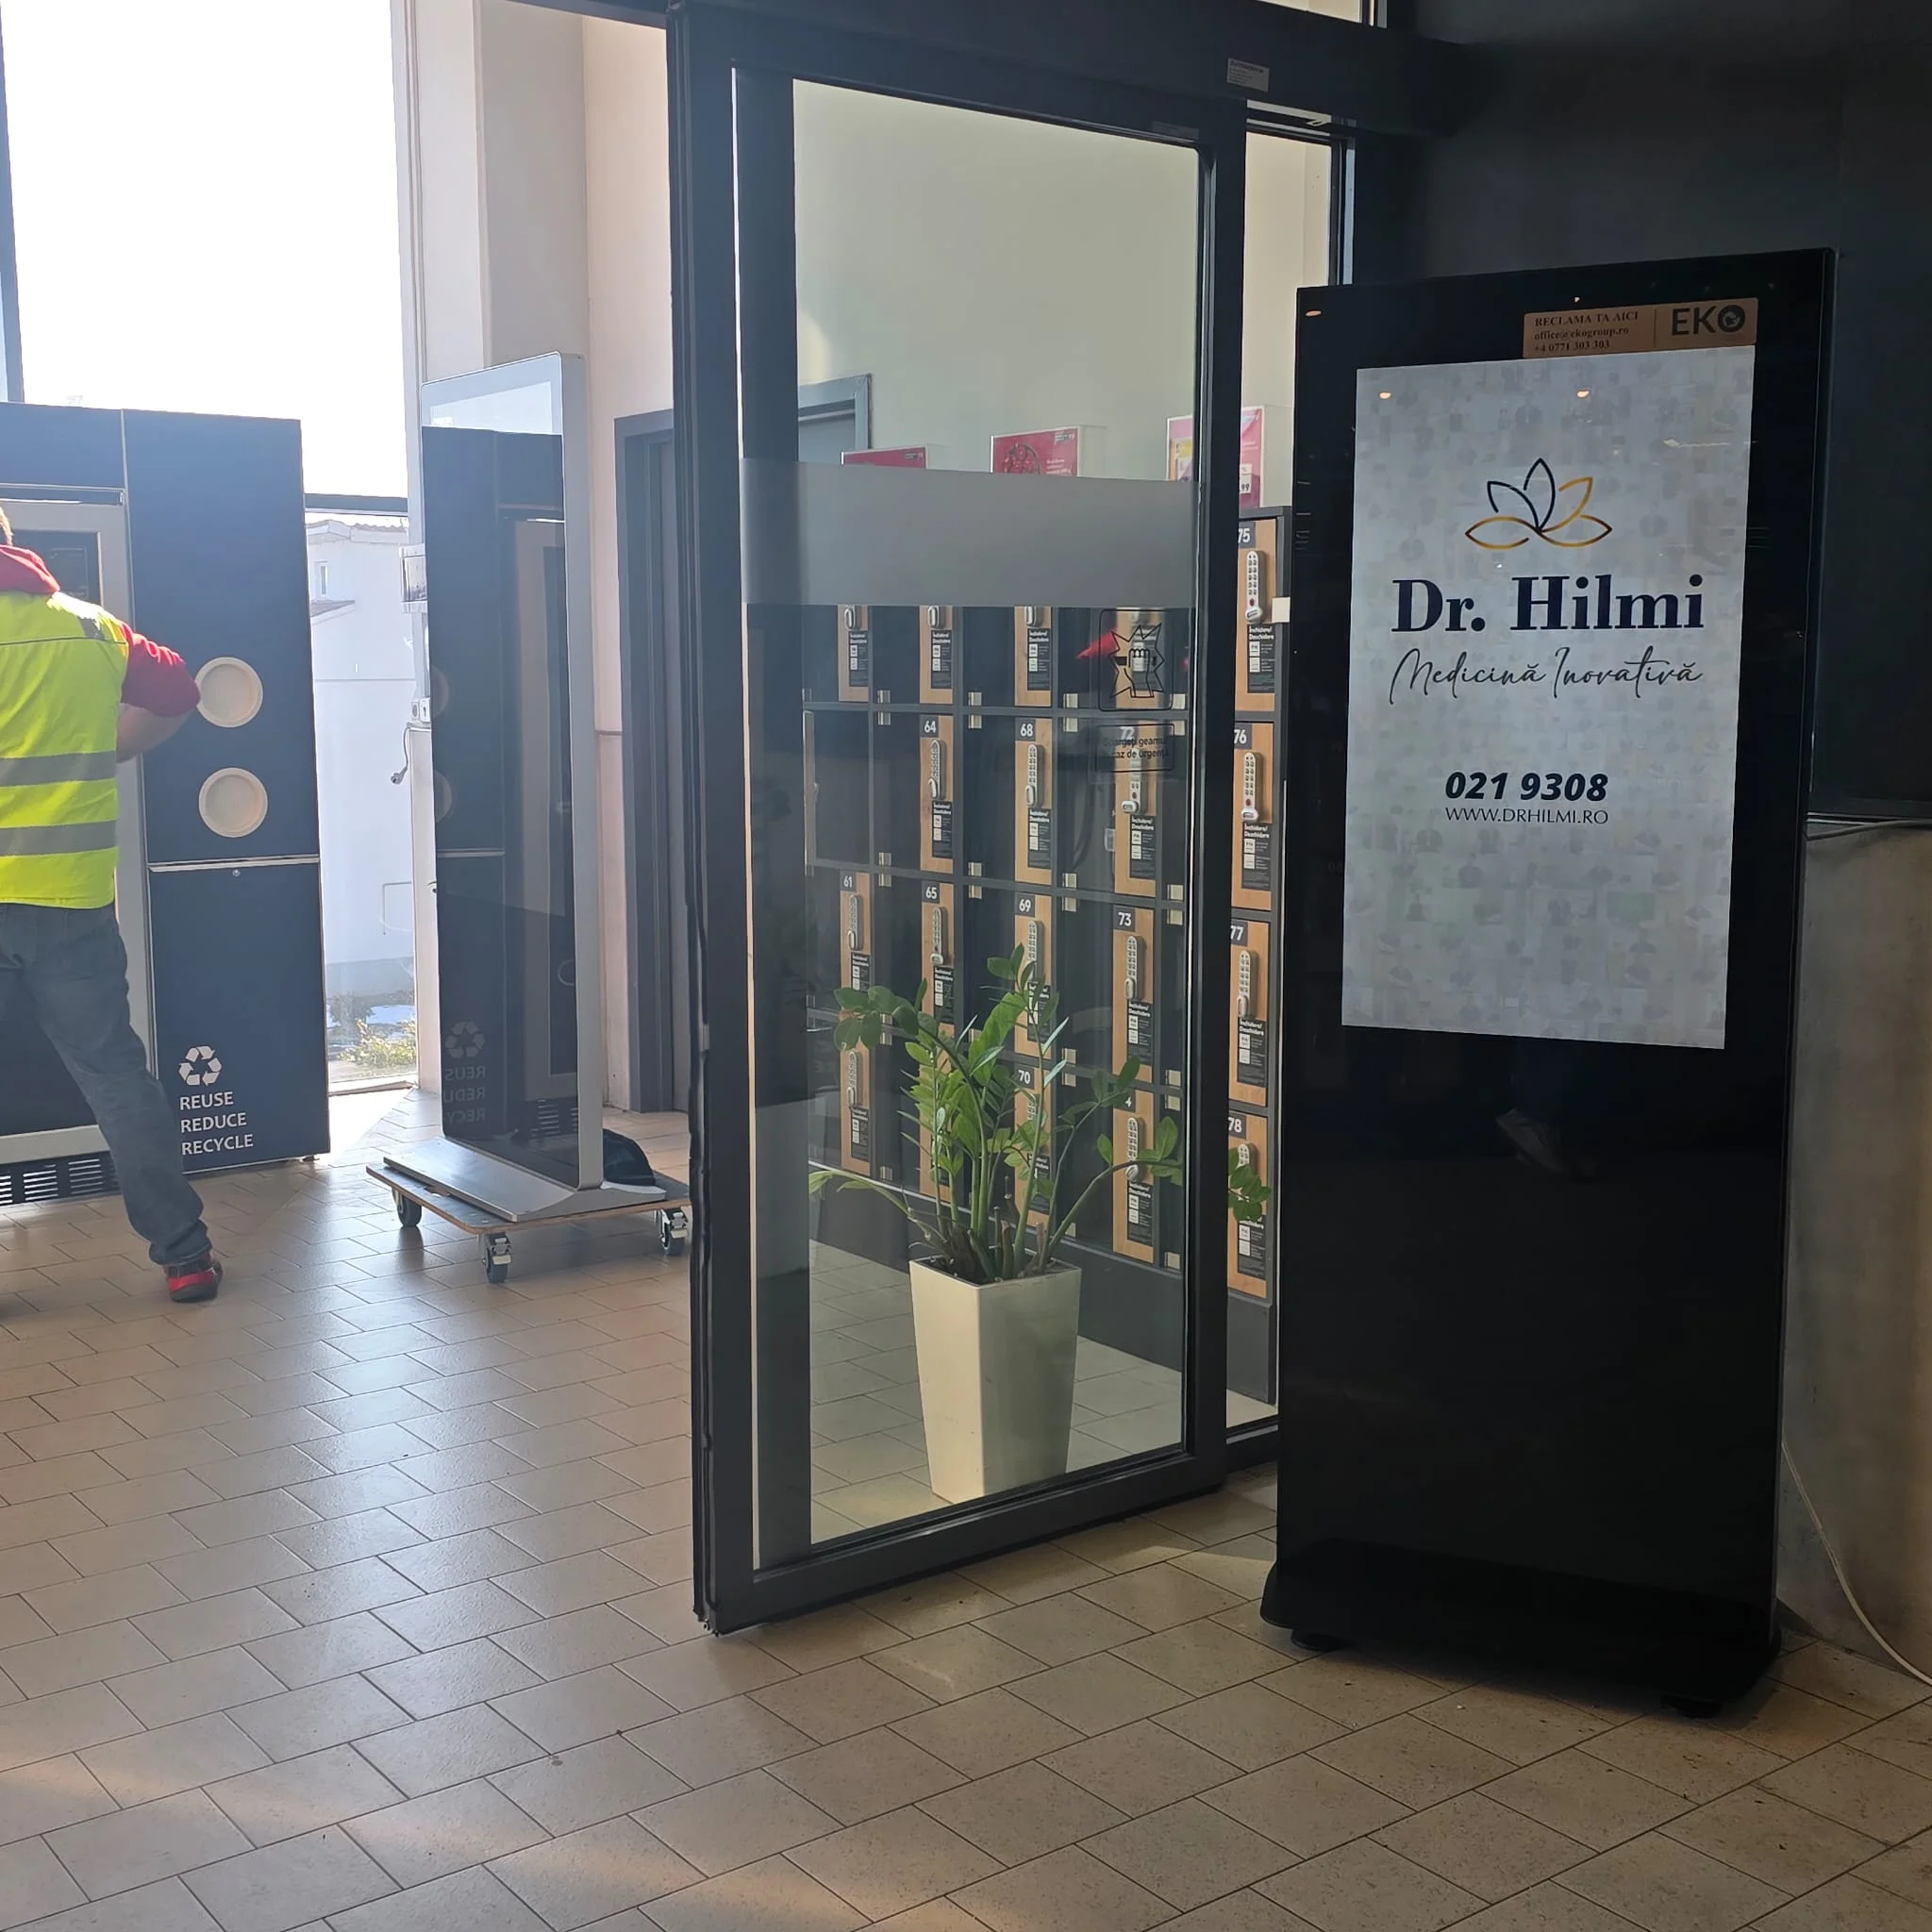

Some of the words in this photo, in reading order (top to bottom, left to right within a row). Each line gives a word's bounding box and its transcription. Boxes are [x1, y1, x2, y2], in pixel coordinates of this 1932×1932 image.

[1535, 314, 1591, 327] RECLAMA
[1596, 312, 1610, 323] TA
[1613, 310, 1639, 321] AICI
[1671, 305, 1745, 336] EKO
[1534, 327, 1629, 341] office@ekogroup.ro
[1548, 342, 1570, 352] 0771
[1573, 341, 1591, 351] 303
[1592, 340, 1610, 349] 303
[1238, 527, 1251, 544] 75
[1391, 578, 1486, 632] Dr.
[1509, 574, 1705, 630] Hilmi
[1389, 647, 1547, 706] Medicină
[1547, 645, 1704, 699] Inovativă
[924, 720, 937, 733] 64
[1020, 724, 1034, 737] 68
[1234, 729, 1247, 744] 76
[1444, 771, 1508, 800] 021
[1520, 772, 1608, 802] 9308
[1444, 807, 1609, 825] WWW.DRHILMI.RO
[843, 875, 853, 888] 61
[925, 887, 938, 899] 65
[1019, 899, 1031, 912] 69
[1118, 912, 1132, 926] 73
[1230, 925, 1244, 941] 77
[1018, 1070, 1031, 1084] 70
[179, 1091, 235, 1111] REUSE
[180, 1111, 248, 1133] REDUCE
[1227, 1117, 1242, 1133] 78
[181, 1133, 255, 1157] RECYCLE
